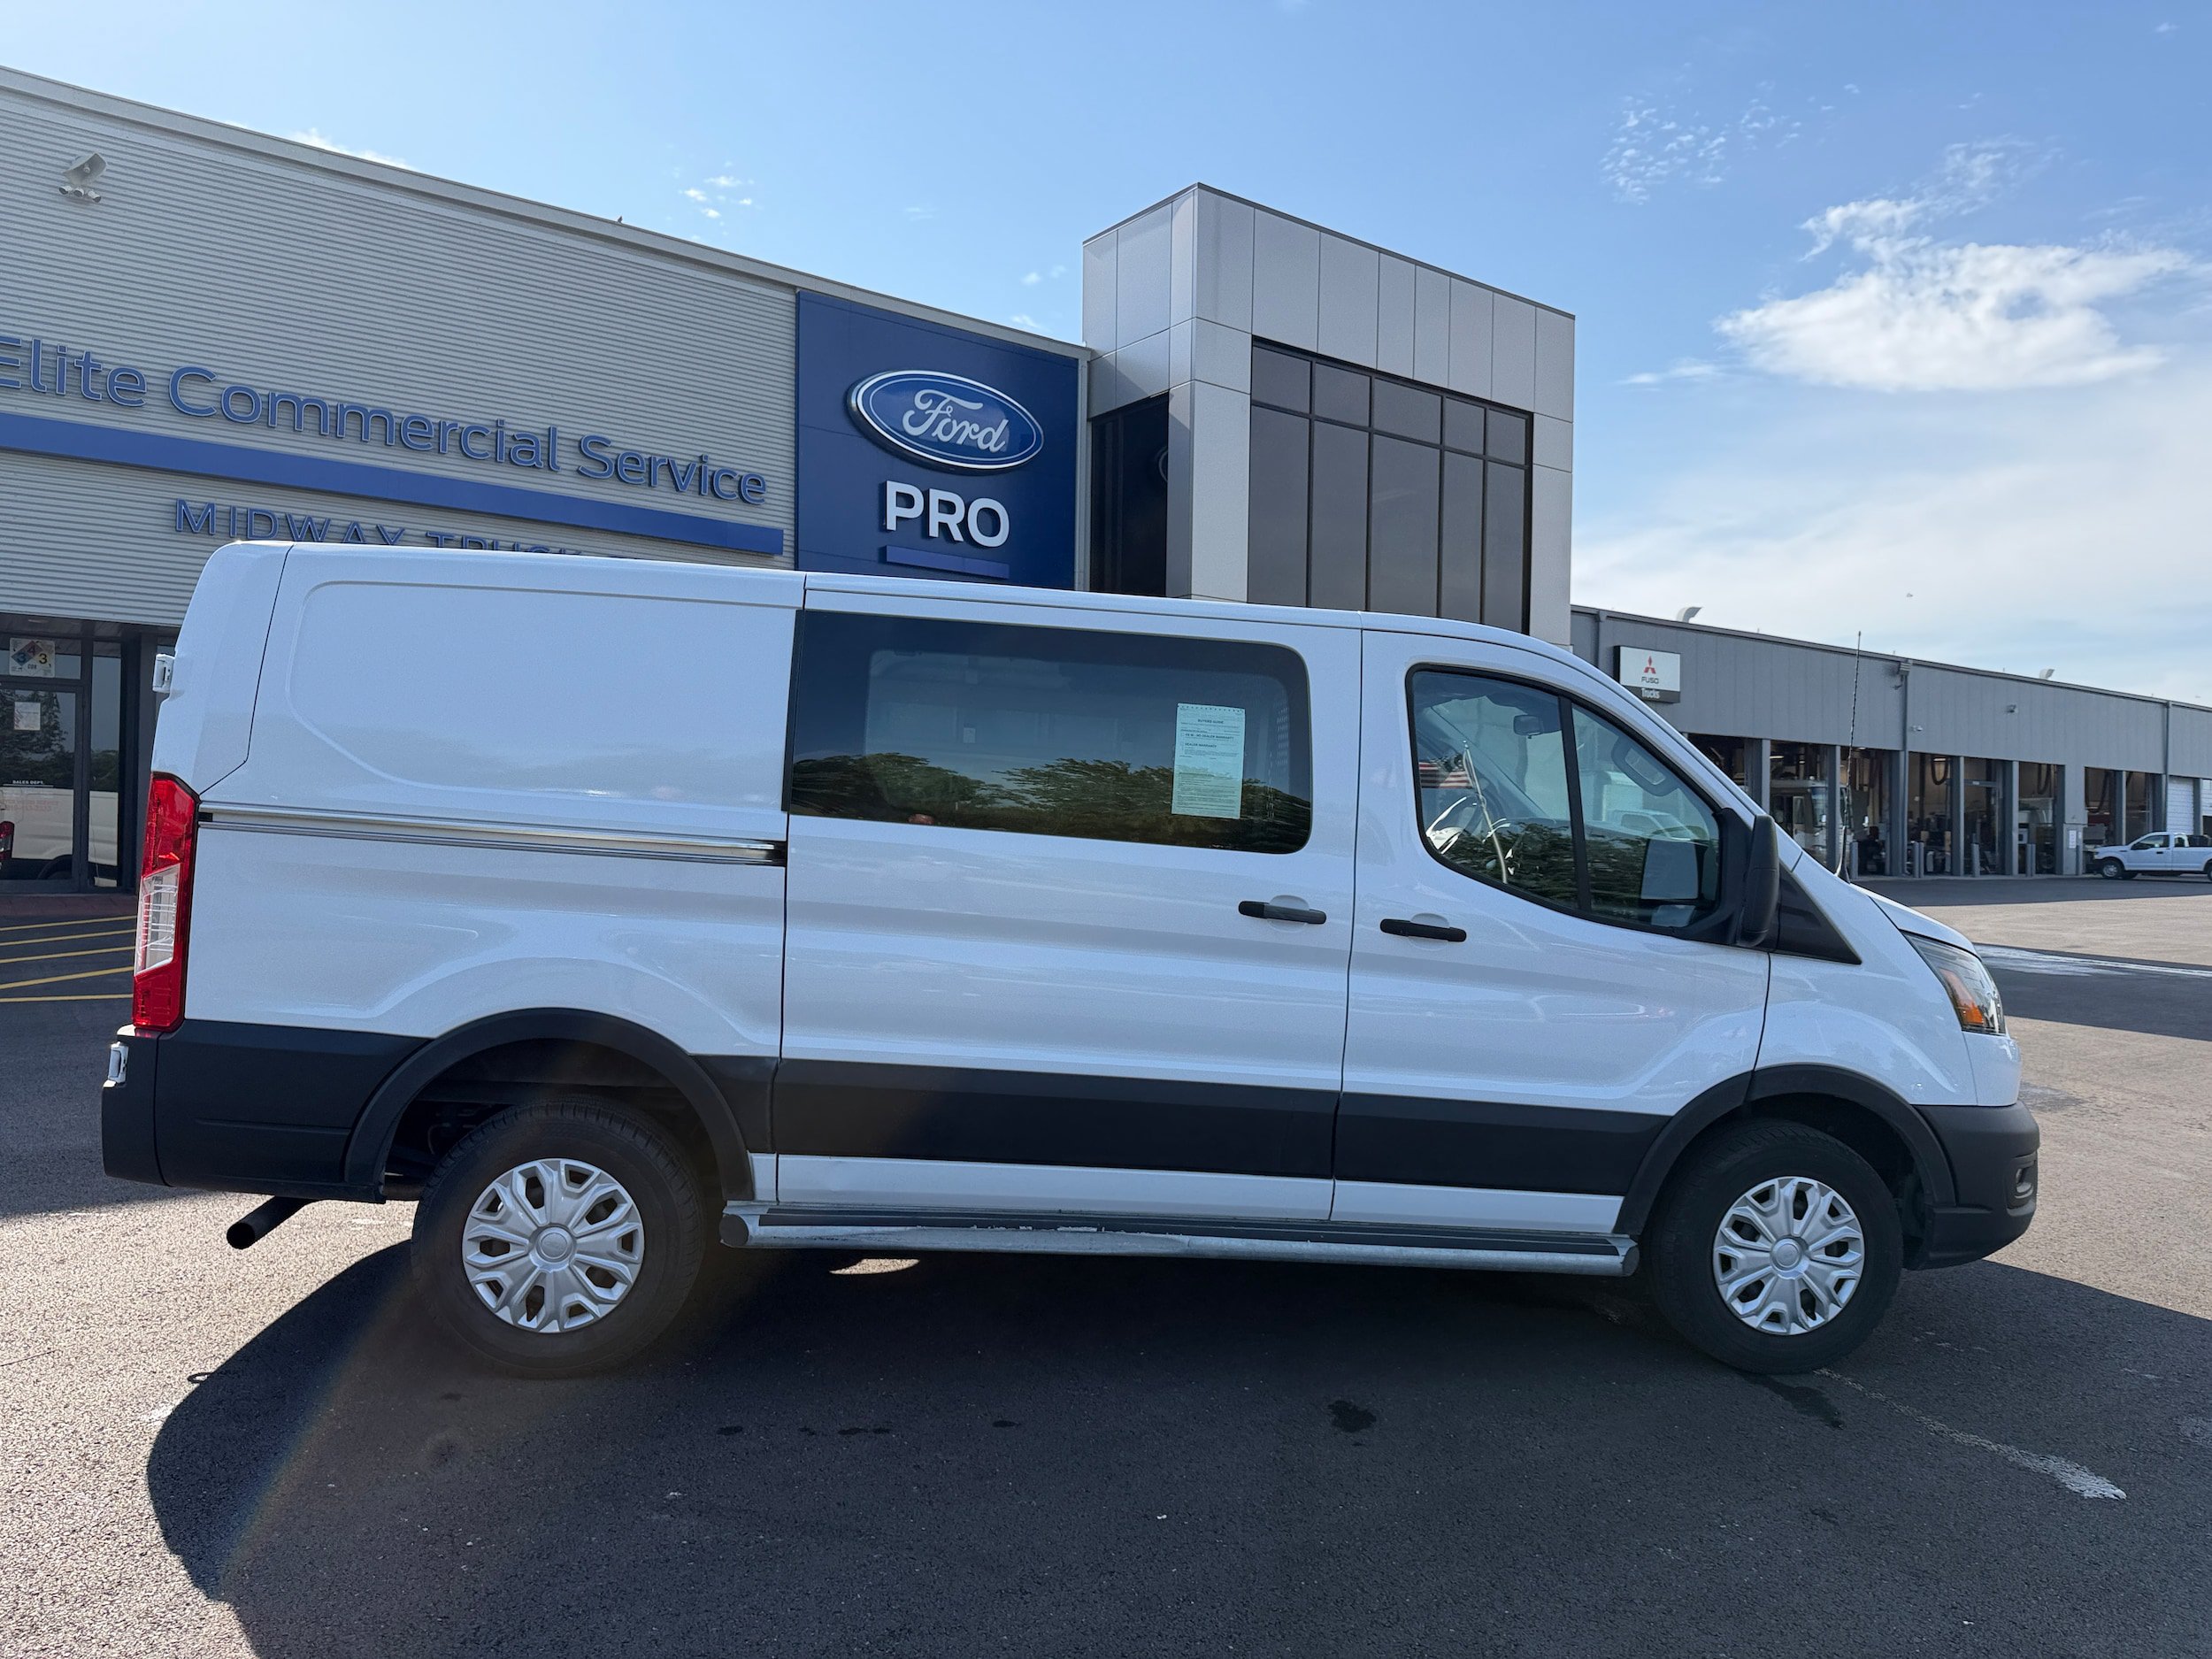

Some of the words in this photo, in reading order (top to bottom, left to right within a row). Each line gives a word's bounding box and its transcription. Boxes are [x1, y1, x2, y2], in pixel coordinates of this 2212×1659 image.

[0, 335, 148, 408] Elite
[168, 366, 562, 472] Commercial
[577, 434, 768, 505] Service
[902, 388, 1009, 453] Ford
[175, 499, 405, 546] MIDWAY
[886, 480, 1010, 547] PRO
[17, 652, 27, 664] 3
[39, 653, 48, 664] 3
[27, 645, 35, 656] 4
